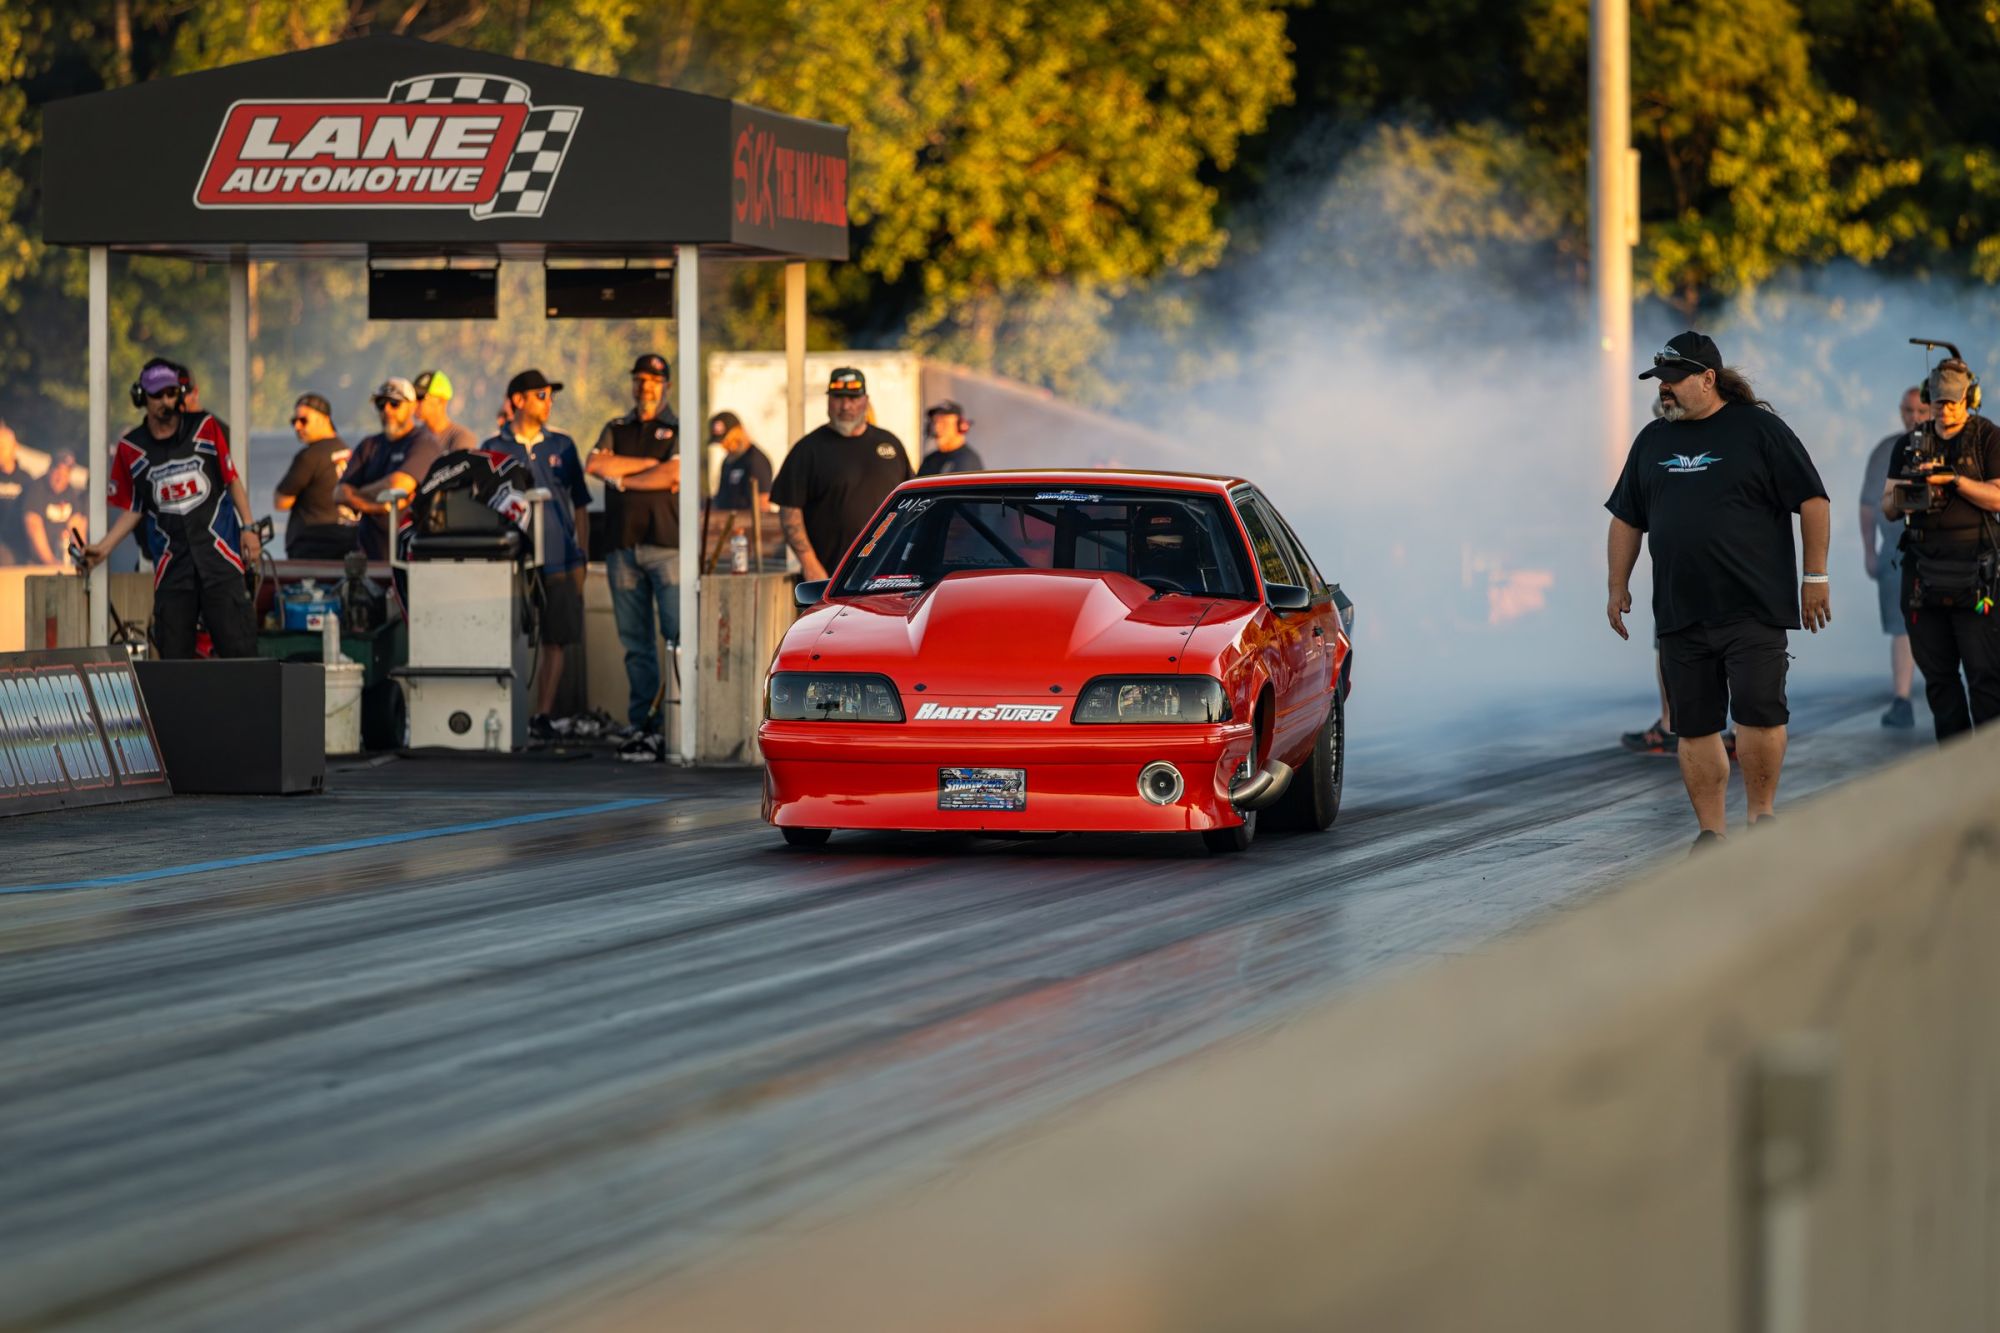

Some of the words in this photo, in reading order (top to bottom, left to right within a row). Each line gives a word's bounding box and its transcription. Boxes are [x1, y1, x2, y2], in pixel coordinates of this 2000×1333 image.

[238, 115, 503, 161] LANE
[219, 166, 487, 193] AUTOMOTIVE
[160, 479, 198, 502] 131
